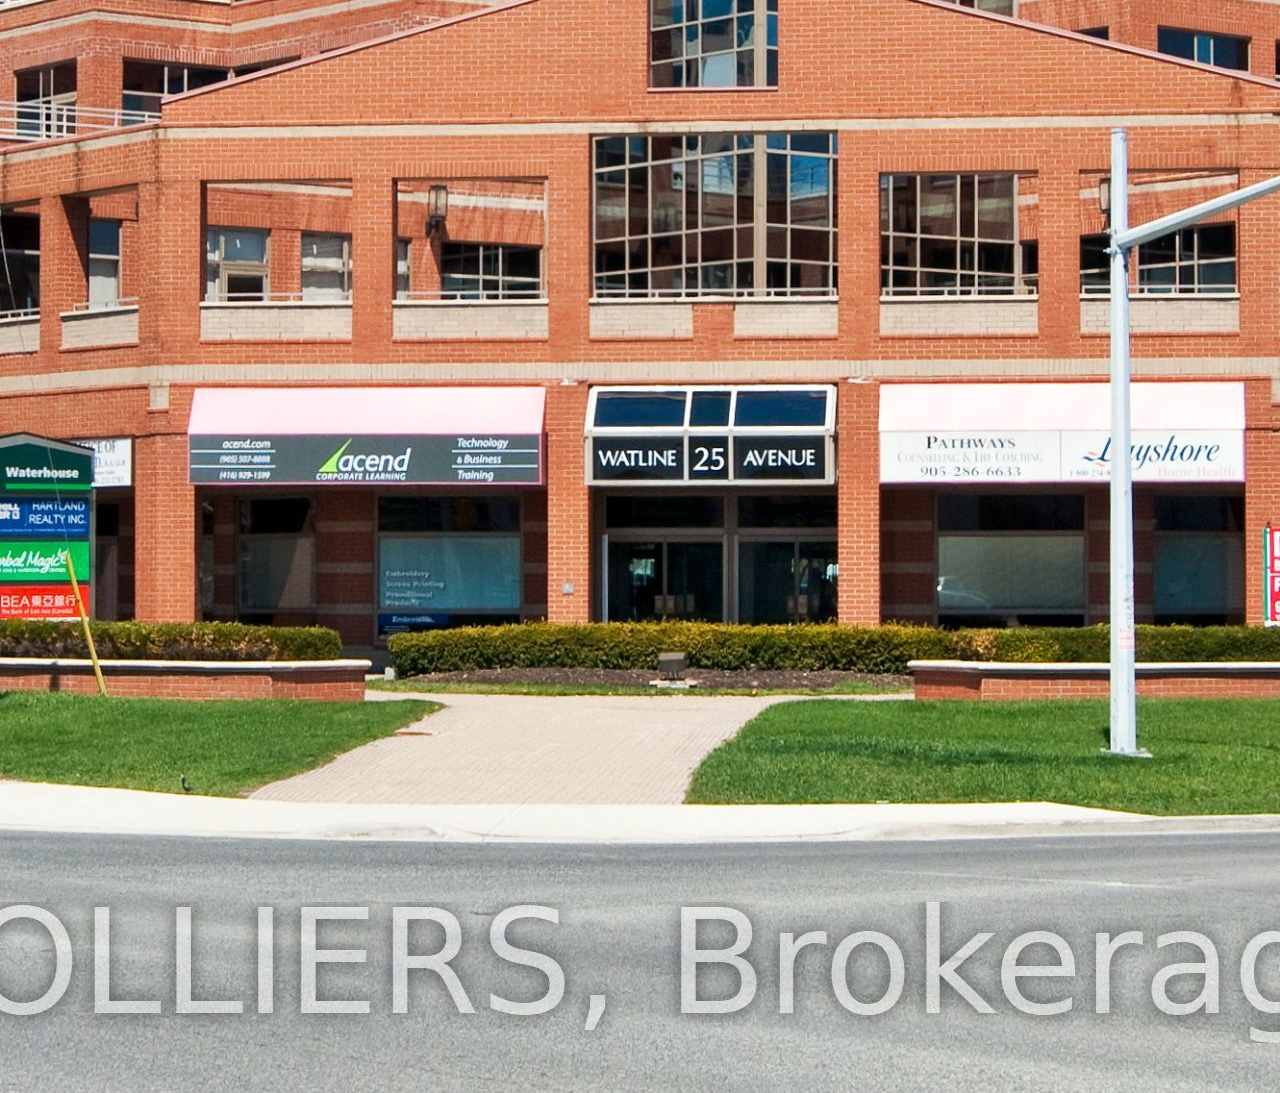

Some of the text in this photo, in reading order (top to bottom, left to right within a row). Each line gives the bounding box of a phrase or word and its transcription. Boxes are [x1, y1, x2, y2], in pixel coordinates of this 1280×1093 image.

[222, 439, 271, 449] acend.com
[457, 438, 509, 450] Technology
[927, 436, 1016, 449] PATHWAYS
[338, 447, 412, 472] acend
[464, 455, 502, 464] Business
[598, 447, 816, 471] WATLINE 25 AVENUE
[5, 466, 79, 480] Waterhouse
[316, 473, 406, 481] CORPORATE LEARNING
[457, 470, 494, 482] Training
[920, 466, 1021, 477] 905-286-6633
[33, 502, 85, 511] HARTLAND
[29, 514, 66, 524] REALTY
[68, 514, 87, 524] INC.
[26, 550, 60, 574] Magic
[0, 595, 30, 608] BEA
